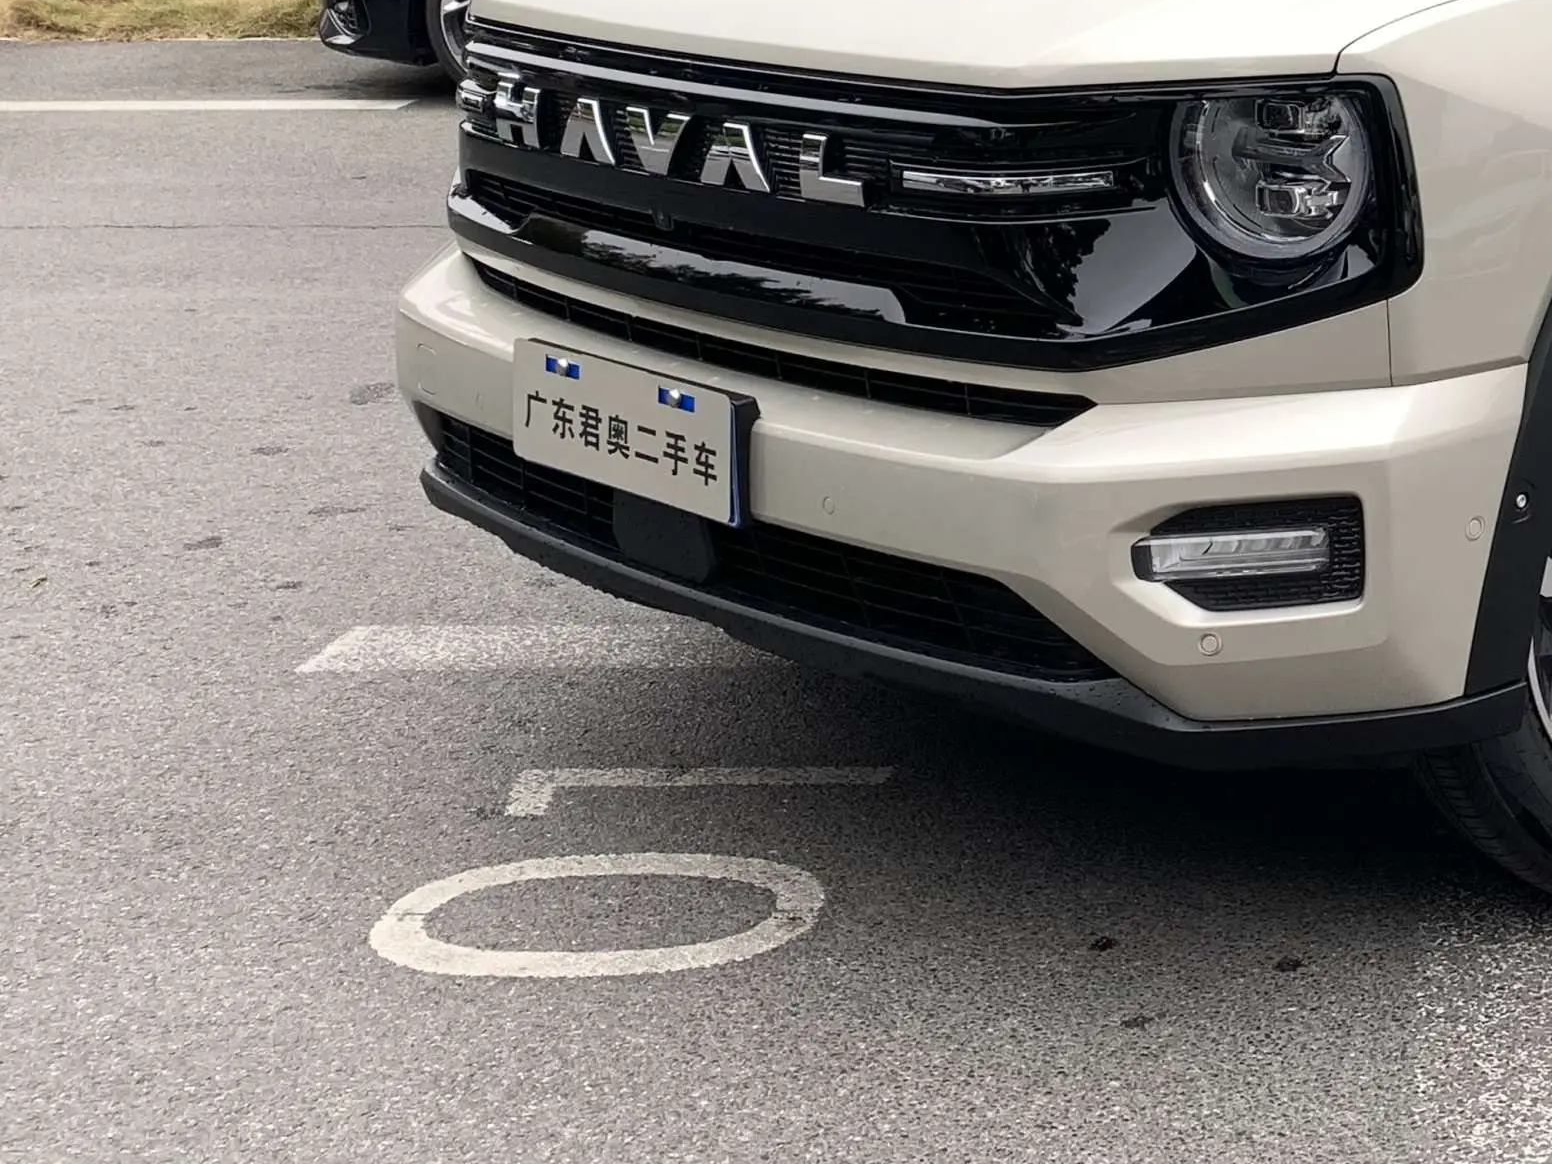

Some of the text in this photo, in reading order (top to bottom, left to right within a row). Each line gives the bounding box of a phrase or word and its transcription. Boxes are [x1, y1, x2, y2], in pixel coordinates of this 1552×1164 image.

[495, 80, 866, 208] HAVAL
[524, 390, 718, 486] 广东君奥二手车
